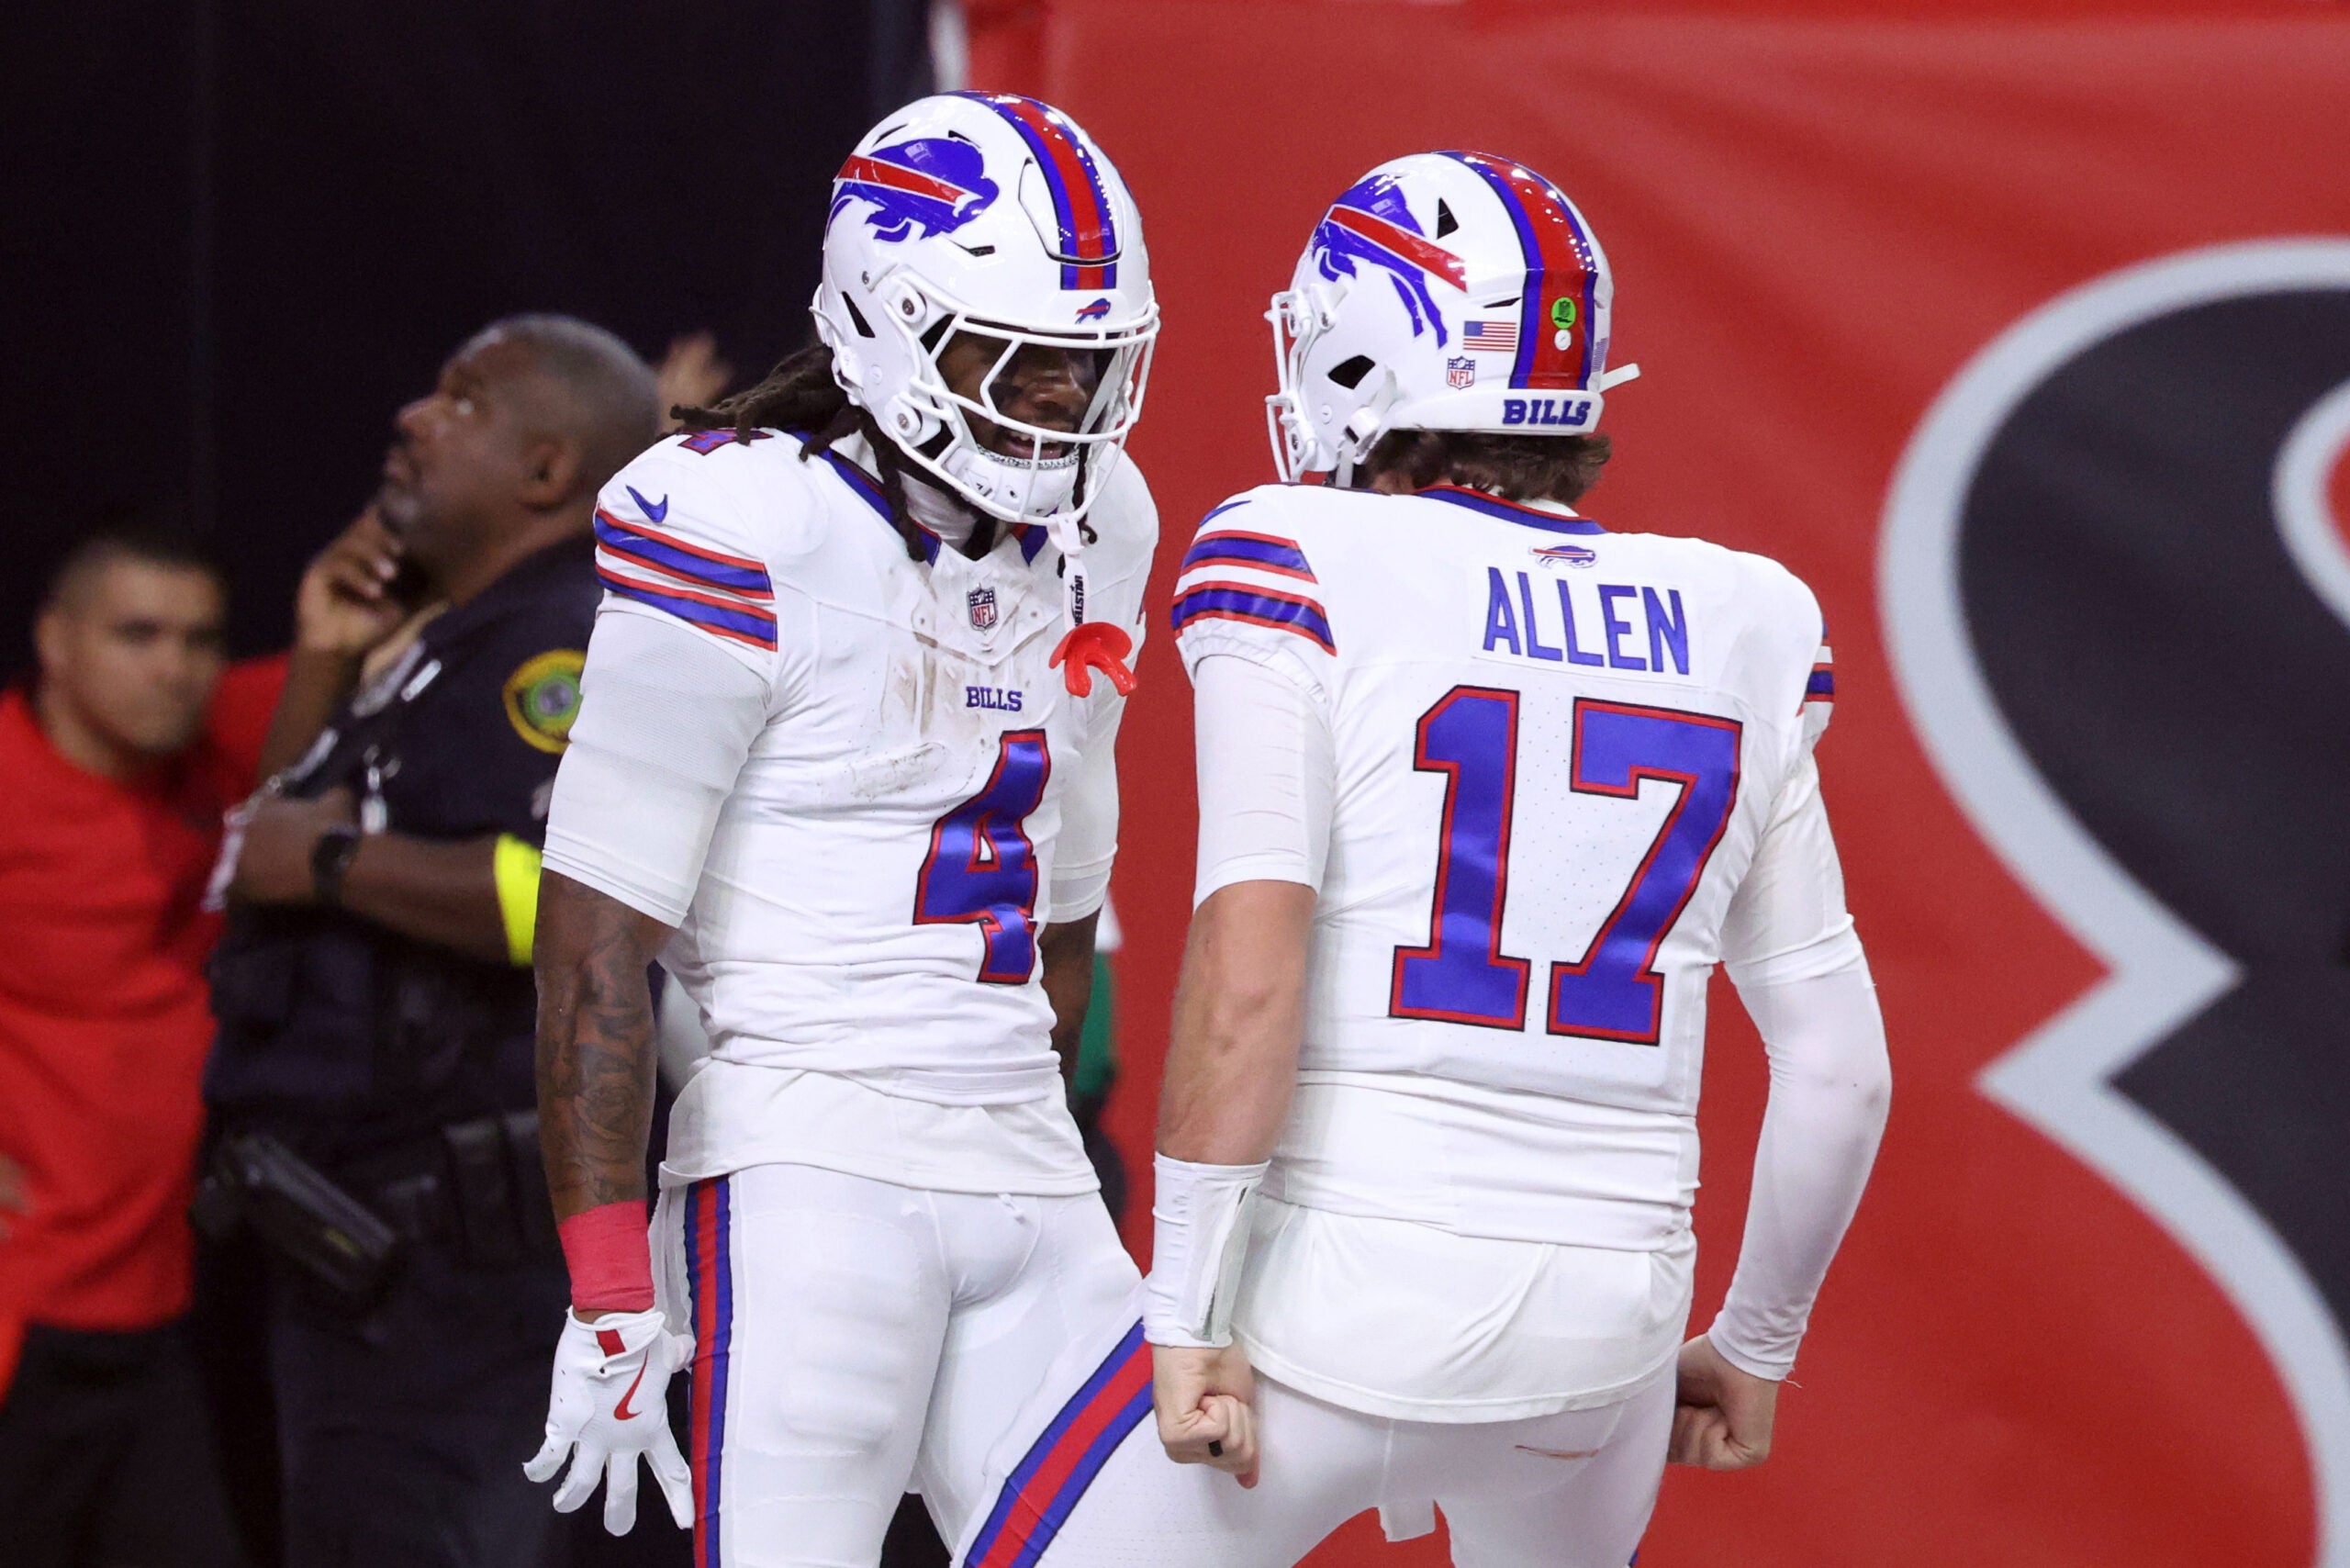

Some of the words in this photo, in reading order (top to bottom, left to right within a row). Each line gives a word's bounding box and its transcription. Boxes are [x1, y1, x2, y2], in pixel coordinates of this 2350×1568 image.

[1449, 370, 1472, 386] NFL
[1502, 398, 1592, 427] BILLS
[972, 605, 994, 624] NFL
[1483, 566, 1690, 676] ALLEN
[966, 685, 1023, 712] BILLS
[912, 728, 1052, 986] 4
[1389, 684, 1743, 1047] 17
